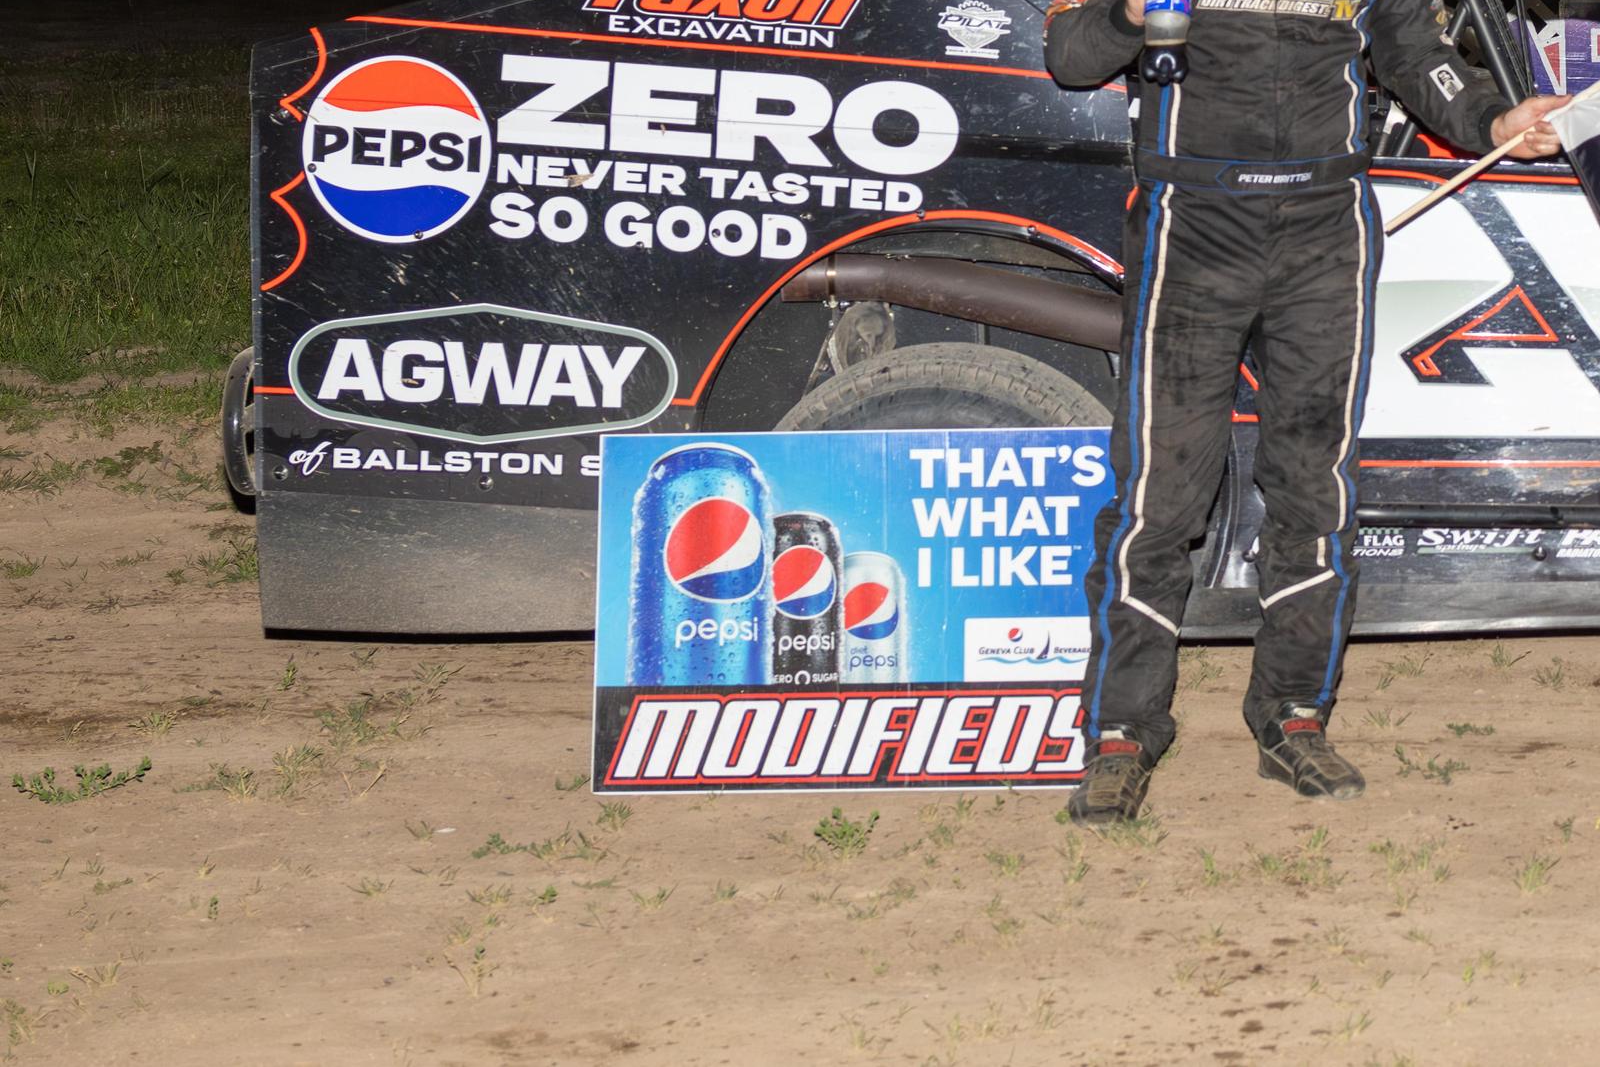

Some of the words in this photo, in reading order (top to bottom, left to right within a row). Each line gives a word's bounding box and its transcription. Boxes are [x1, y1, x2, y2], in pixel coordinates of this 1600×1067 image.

[607, 15, 835, 49] EXCAVATION
[497, 54, 960, 175] ZERO
[311, 124, 483, 173] PEPSI
[497, 153, 688, 197] NEVER
[700, 167, 924, 213] TASTED
[1238, 173, 1273, 183] PETER
[489, 192, 590, 244] SO
[604, 200, 808, 260] GOOD
[317, 338, 646, 409] AGWAY
[289, 441, 332, 475] of
[332, 448, 563, 475] BALLSTON
[909, 445, 1106, 488] THAT'S
[912, 496, 1080, 537] WHAT
[1363, 535, 1405, 547] FLAG
[918, 548, 932, 587] I
[951, 546, 1074, 587] LIKE
[675, 617, 759, 648] pepsi
[778, 632, 836, 655] pepsi
[979, 646, 1011, 654] GENEVA
[1013, 646, 1035, 654] CLUB
[849, 653, 899, 671] pepsi
